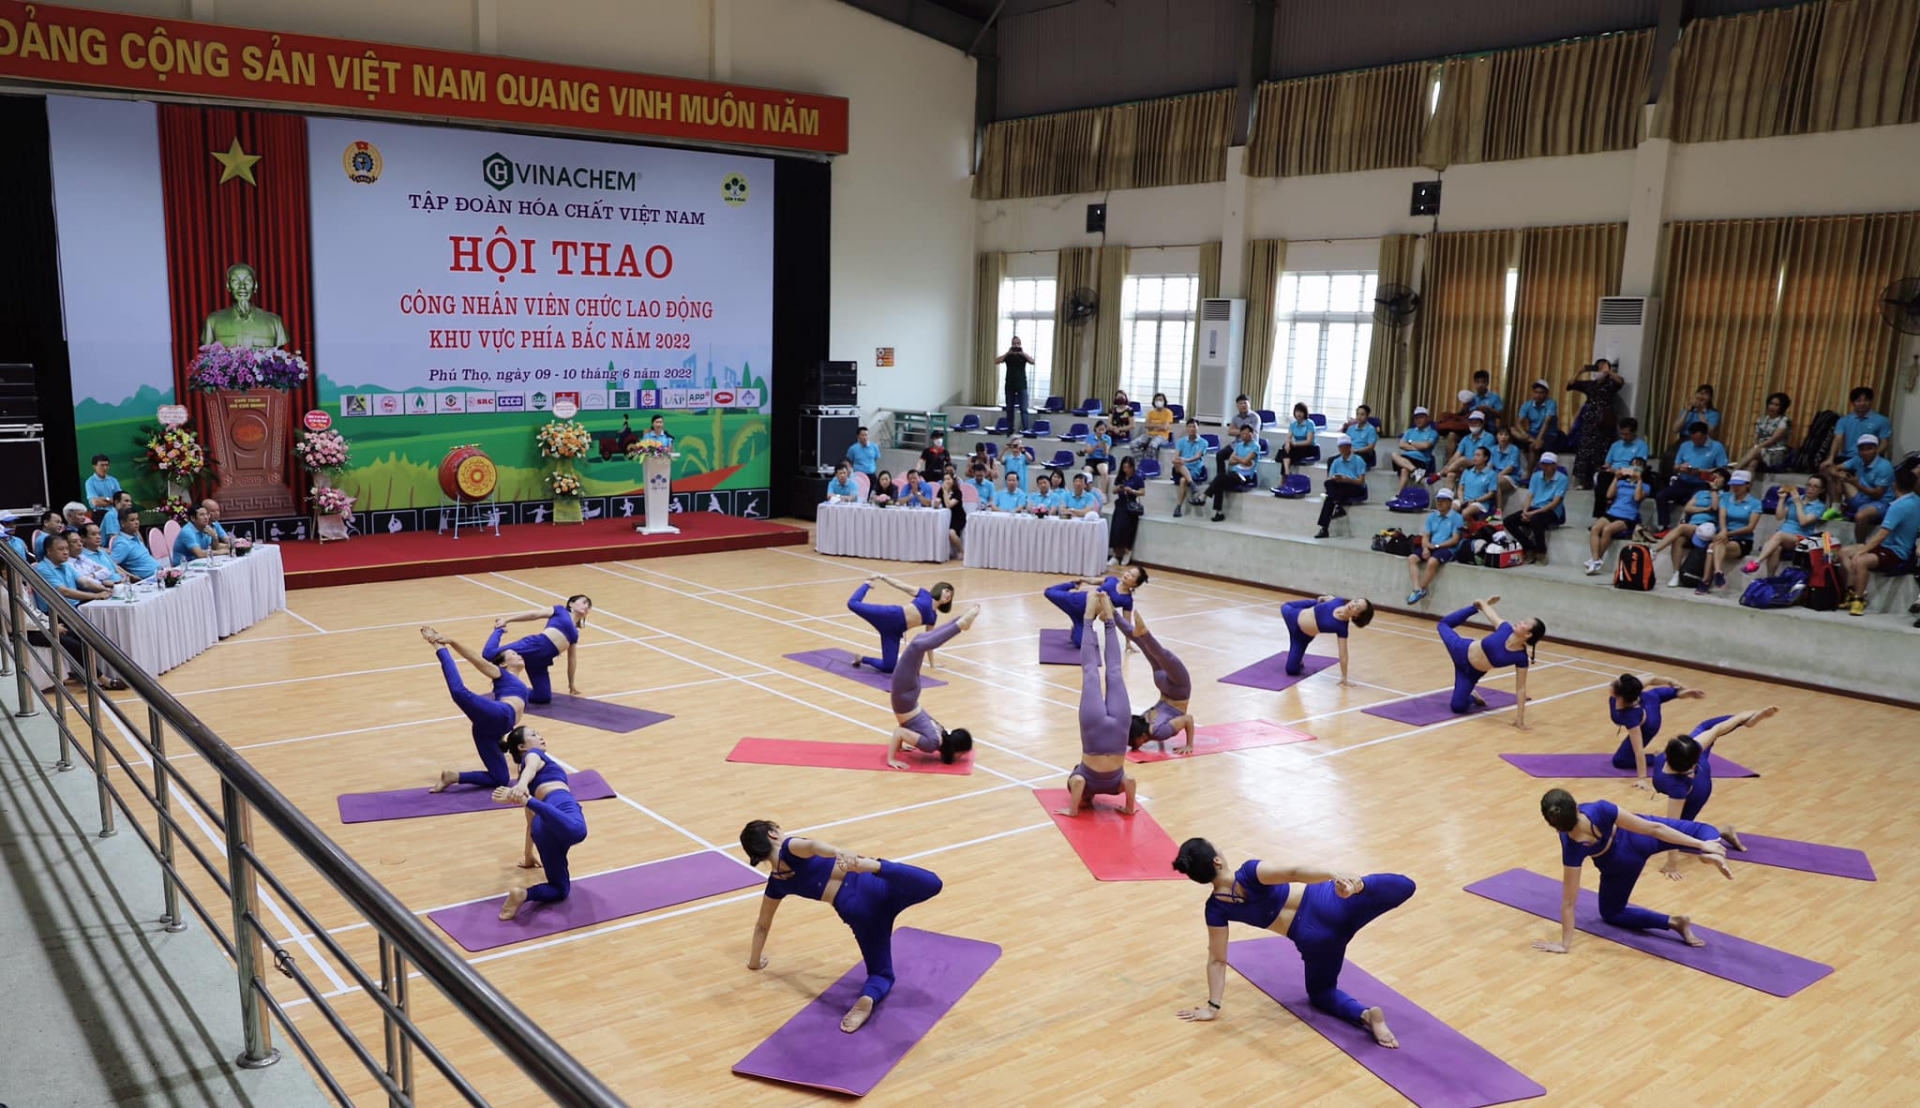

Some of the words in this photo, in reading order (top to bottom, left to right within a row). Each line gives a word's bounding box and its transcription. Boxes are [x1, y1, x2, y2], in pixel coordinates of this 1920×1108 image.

[0, 5, 108, 66] ĐẢNG
[120, 26, 230, 82] CỘNG
[242, 35, 316, 86] SẢN
[327, 50, 402, 100] VIỆT
[413, 64, 486, 102] NAM
[496, 73, 600, 113] QUANG
[609, 86, 672, 121] VINH
[680, 91, 755, 129] MUÔN
[762, 98, 819, 136] NĂM
[515, 163, 636, 191] VINACHEM
[409, 191, 448, 213] TẬP
[455, 194, 511, 214] ĐOÀN
[518, 198, 559, 217] HÓA
[565, 199, 613, 220] CHẤT
[619, 204, 660, 225] VIỆT
[665, 210, 705, 225] NAM
[449, 226, 536, 283] HỘI
[552, 241, 673, 279] THAO
[400, 289, 456, 315] CÔNG
[461, 291, 518, 316] NHÂN
[524, 292, 570, 317] VIÊN
[575, 294, 622, 318] CHỨC
[626, 299, 661, 318] LAO
[665, 296, 713, 323] ĐỘNG
[429, 330, 471, 348] KHU
[478, 329, 515, 353] VỰC
[521, 325, 567, 348] PHÍA
[571, 321, 606, 348] BẮC
[611, 327, 651, 349] NĂM
[655, 333, 691, 349] 2022
[428, 368, 457, 381] Phú
[461, 369, 491, 383] Thọ,
[496, 368, 531, 384] ngày
[535, 369, 550, 380] 09
[563, 368, 577, 380] 10
[581, 368, 617, 382] tháng
[622, 369, 630, 380] 6
[633, 369, 660, 380] năm
[664, 369, 692, 379] 2022
[689, 393, 705, 401] APP
